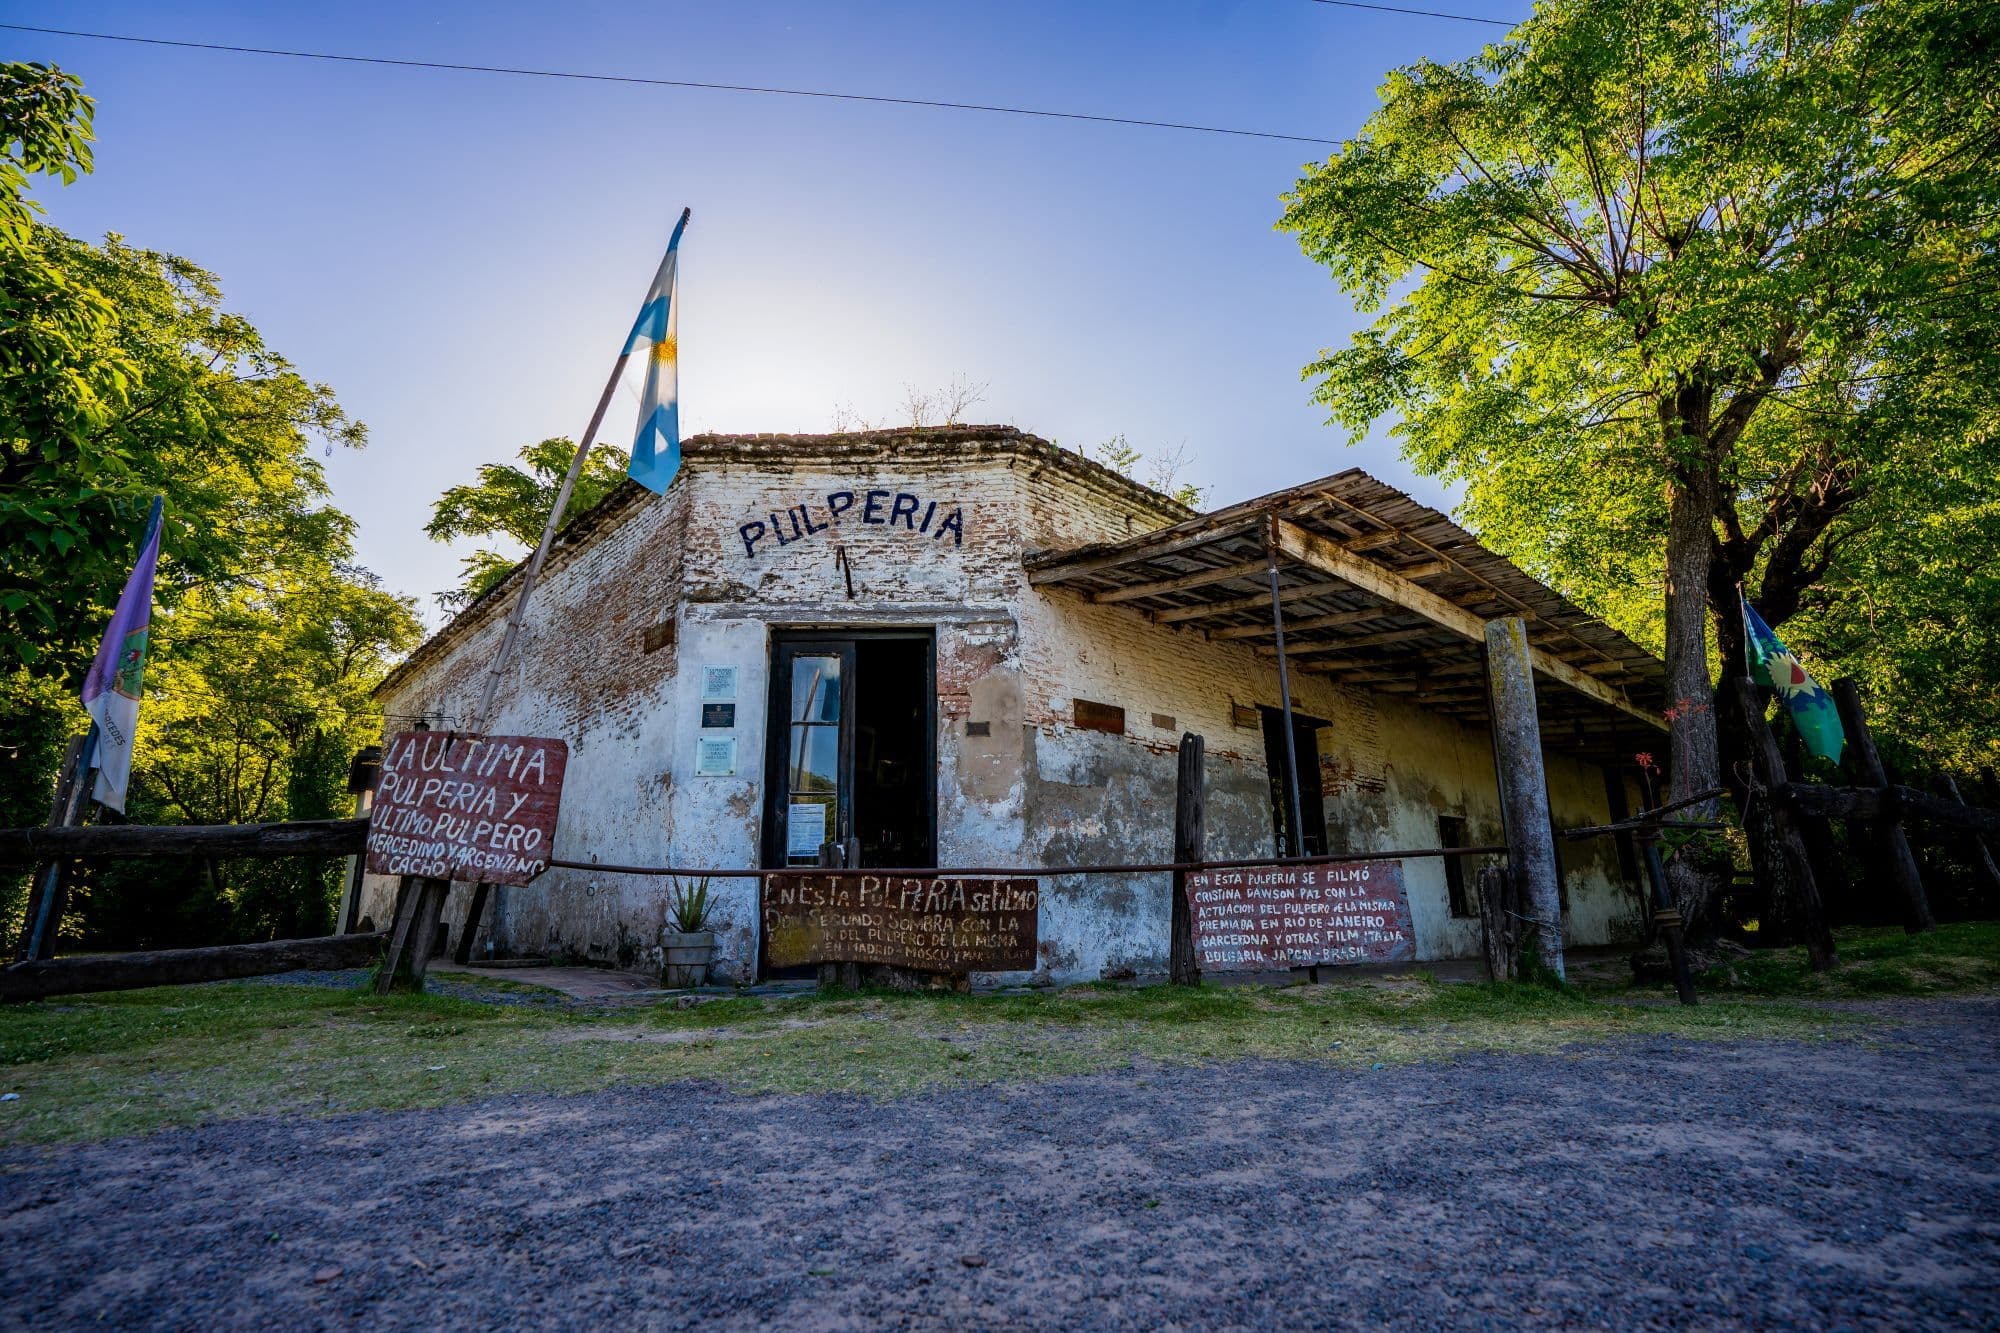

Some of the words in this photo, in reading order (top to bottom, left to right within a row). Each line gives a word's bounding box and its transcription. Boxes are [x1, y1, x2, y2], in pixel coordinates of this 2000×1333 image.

[739, 490, 964, 559] PULPERIA
[383, 738, 415, 772] LA
[421, 736, 546, 785] ULTIMA
[376, 772, 497, 817] PULPERIA
[504, 792, 529, 820] Y
[372, 804, 432, 835] ULTIMO
[431, 812, 543, 851] PULPERO
[367, 831, 446, 859] MERCEDINO
[447, 842, 459, 860] Y
[457, 846, 545, 876] ARGENTINO
[1193, 875, 1209, 886] EN
[1215, 873, 1242, 886] ESTA
[1248, 872, 1296, 885] PULPERIA
[1302, 871, 1316, 884] SE
[1327, 866, 1370, 882] FILMÓ
[800, 875, 850, 907] ESTA
[860, 875, 965, 913] PULPERIA
[971, 892, 991, 912] SE
[1195, 888, 1242, 903] CRISTINA
[1247, 888, 1295, 900] DAWSON
[1300, 888, 1321, 900] PAZ
[1325, 888, 1346, 898] CON
[1350, 885, 1366, 897] LA
[1199, 903, 1255, 918] ACTUACION
[1260, 904, 1281, 914] DEL
[1284, 903, 1330, 915] PULPERO
[1345, 901, 1357, 912] LA
[1359, 900, 1396, 912] MISMA
[809, 909, 883, 928] SEGUNDO
[888, 912, 954, 933] SOMBRA
[961, 917, 991, 932] CON
[999, 917, 1019, 932] LA
[1200, 919, 1255, 931] PREMIADA
[1261, 919, 1279, 930] EN
[1284, 916, 1306, 928] RIO
[1309, 918, 1323, 929] DE
[1327, 915, 1385, 928] JANEIRO
[840, 929, 862, 941] DEL
[932, 934, 948, 947] DE
[953, 935, 969, 947] LA
[976, 934, 1018, 948] MISMA
[1274, 934, 1282, 945] Y
[1285, 932, 1320, 945] OTRAS
[1327, 929, 1359, 942] FILM
[905, 946, 949, 961] MOSCU
[1271, 948, 1312, 961] JAPON
[1323, 946, 1368, 961] BRASIL
